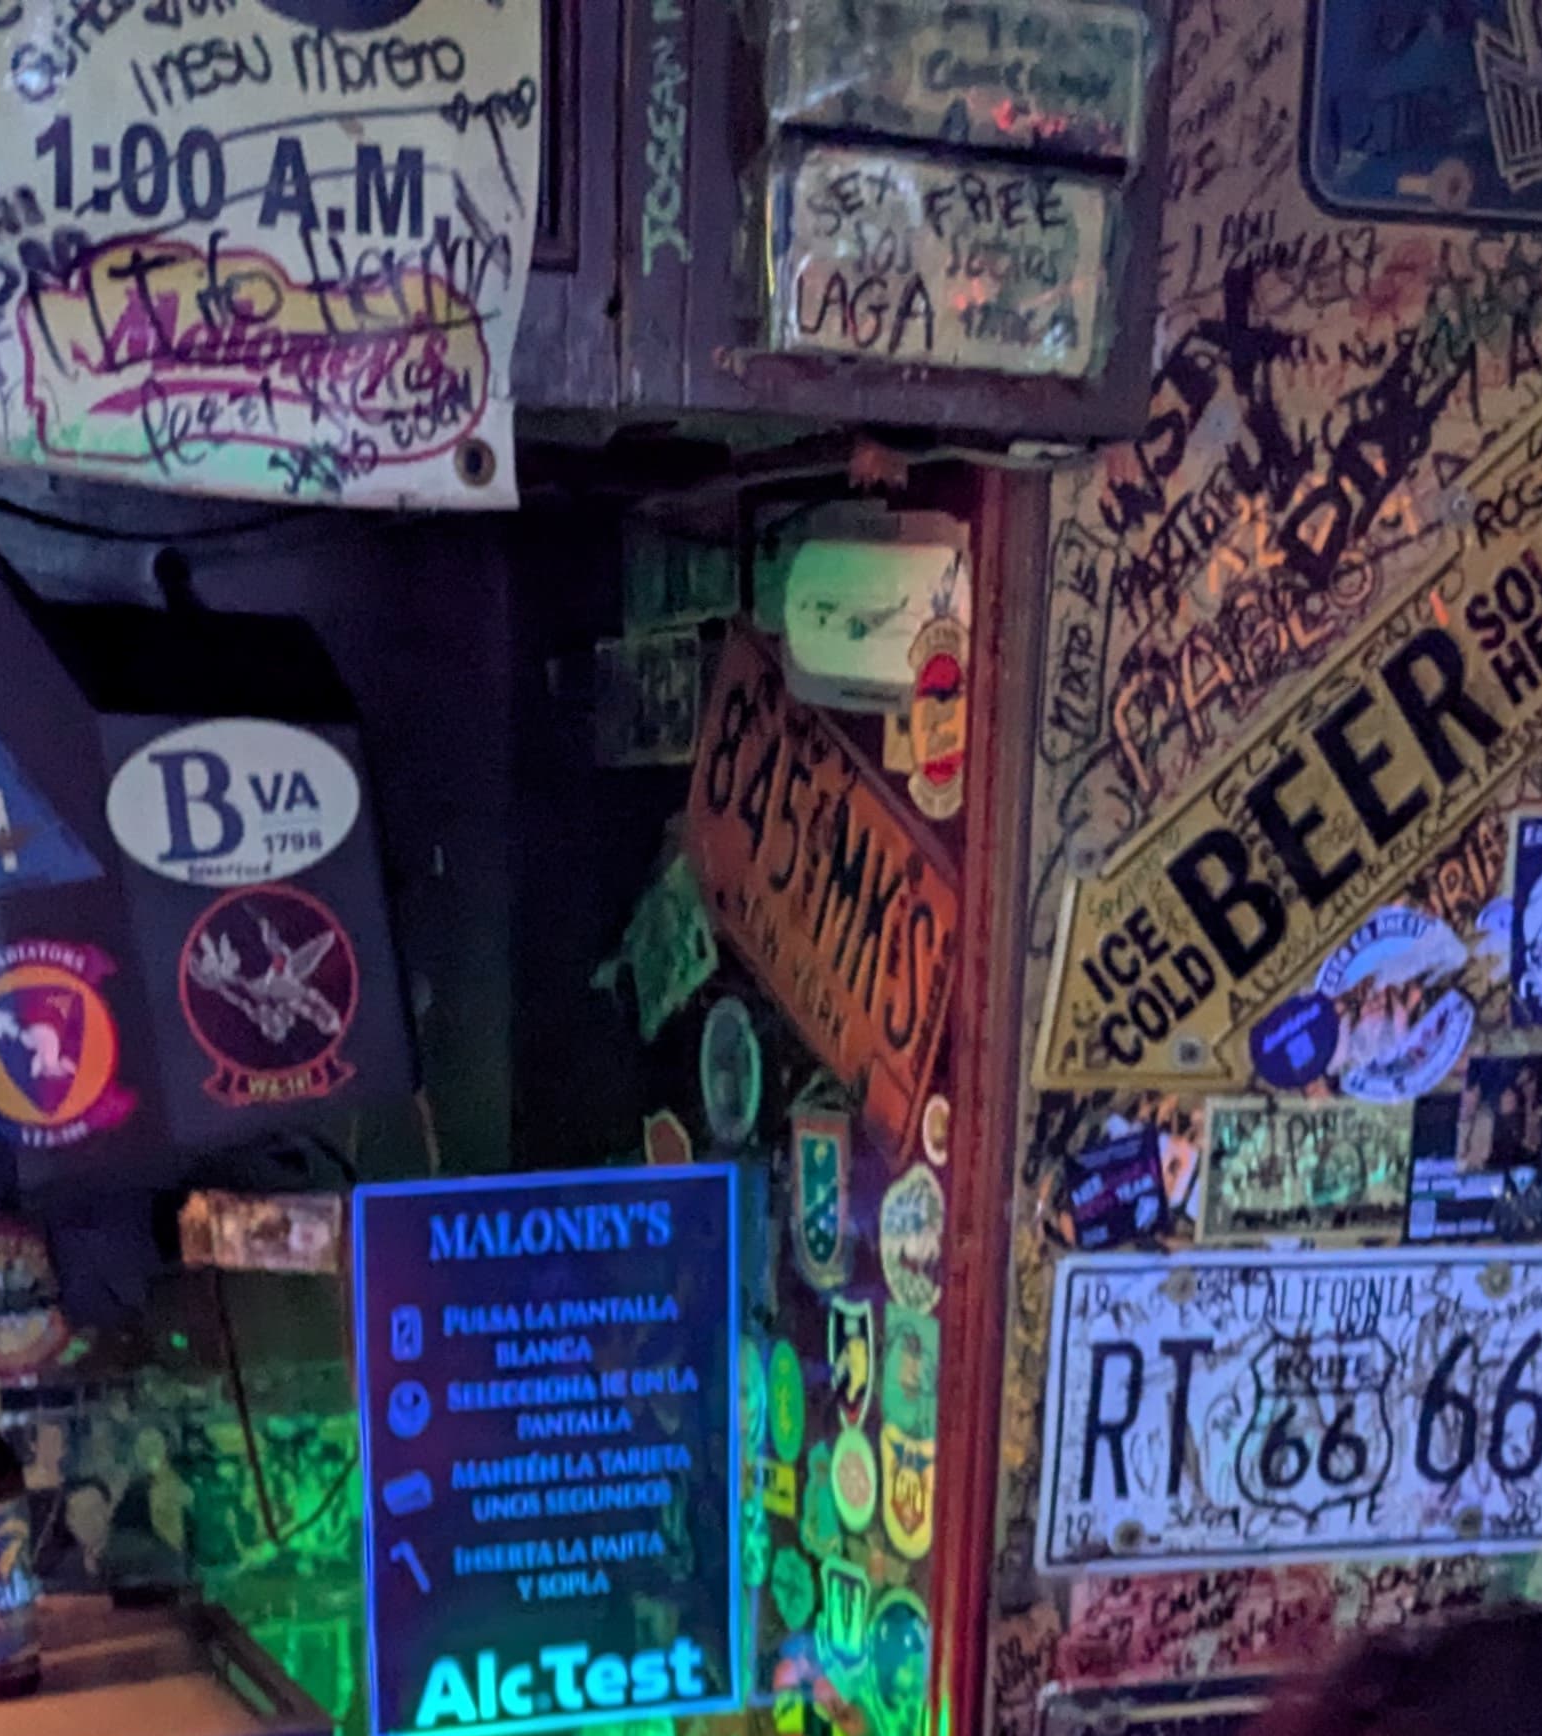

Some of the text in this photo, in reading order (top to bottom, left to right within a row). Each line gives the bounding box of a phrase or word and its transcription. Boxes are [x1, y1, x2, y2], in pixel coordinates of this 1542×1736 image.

[36, 116, 226, 221] 1:00
[258, 136, 452, 239] A.M.
[147, 748, 245, 863] B
[248, 770, 320, 815] VA
[1165, 627, 1506, 981] BEER
[1081, 905, 1171, 1004] ICE
[1100, 944, 1217, 1067] COLD
[427, 1200, 673, 1262] MALONEY'S
[559, 1294, 679, 1327] PANTALLA
[1241, 1273, 1421, 1322] CALIFORNIA
[665, 1364, 699, 1393] LA
[1078, 1337, 1215, 1500] RT
[1259, 1401, 1369, 1489] 66
[563, 1451, 595, 1480] LA
[557, 1537, 587, 1567] LA
